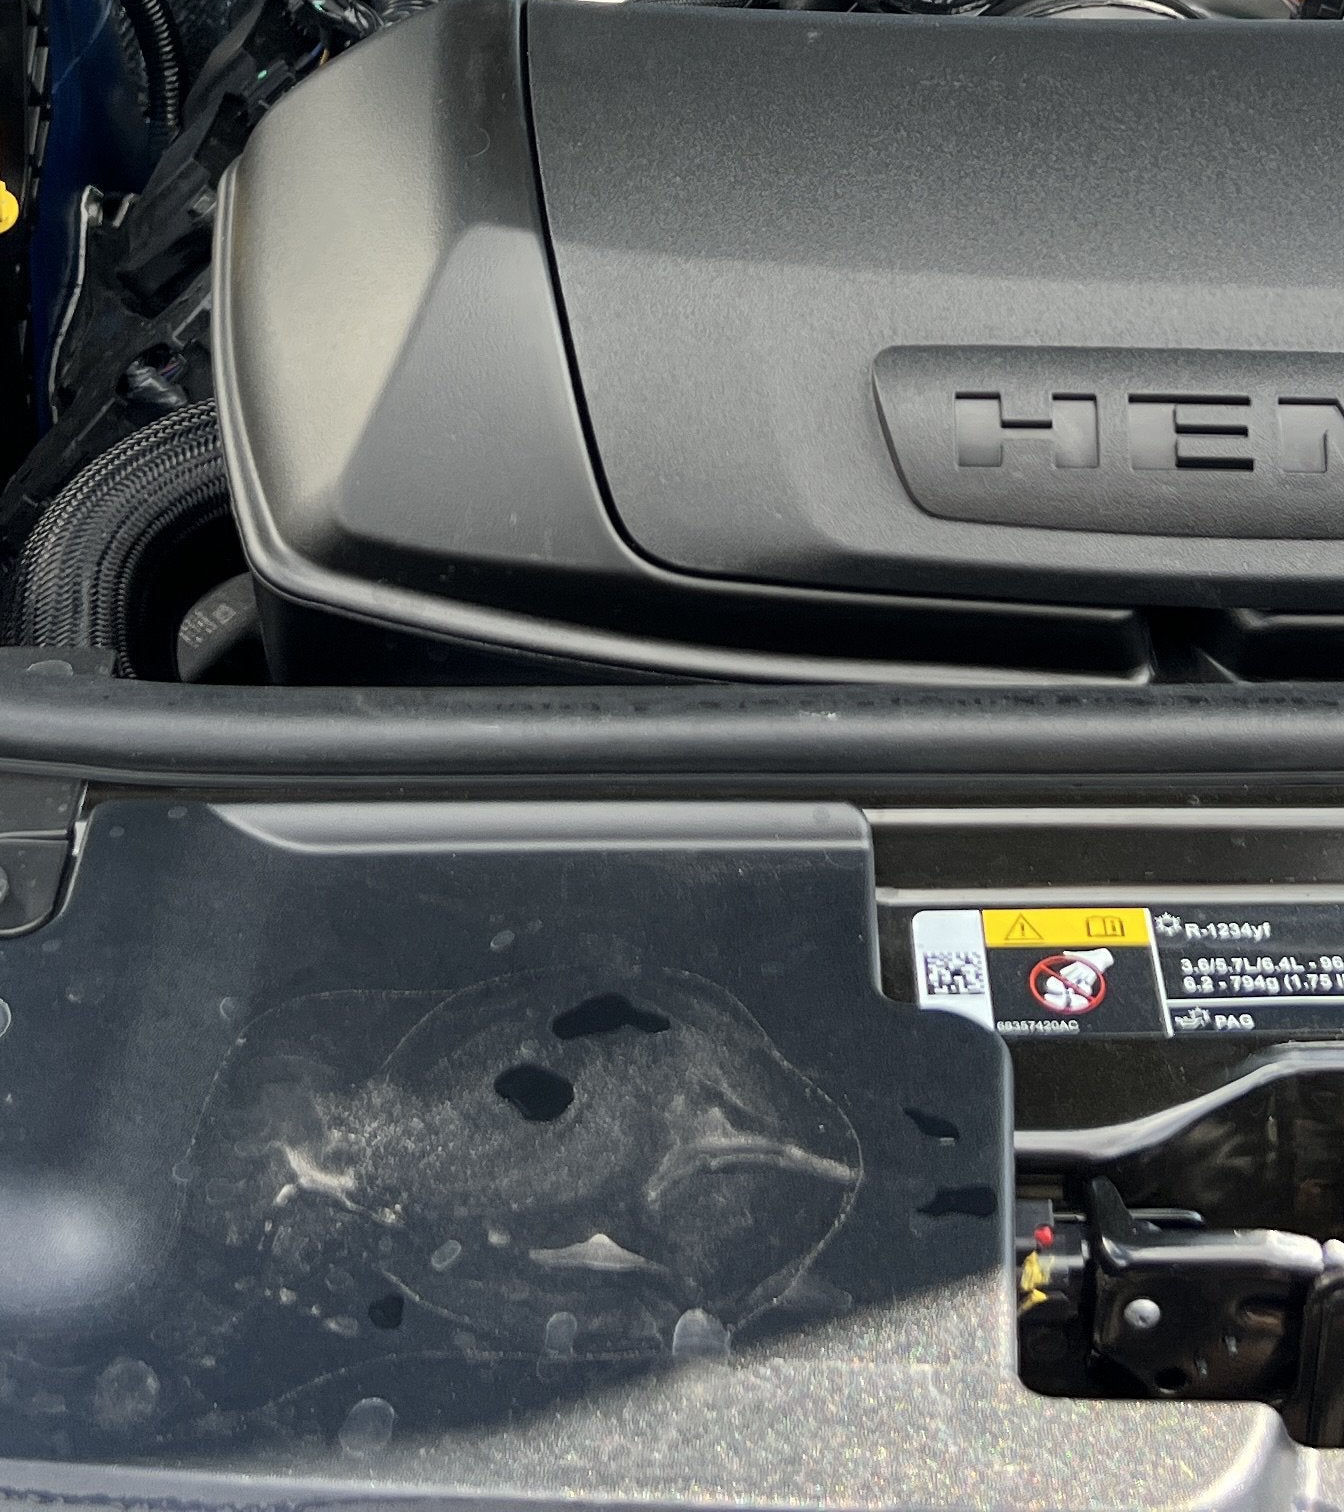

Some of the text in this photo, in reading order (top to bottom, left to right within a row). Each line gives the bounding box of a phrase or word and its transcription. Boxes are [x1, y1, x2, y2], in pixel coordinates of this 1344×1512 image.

[1184, 921, 1271, 942] R-1234yf
[1229, 974, 1280, 994] 794g
[1215, 1014, 1254, 1029] PAG
